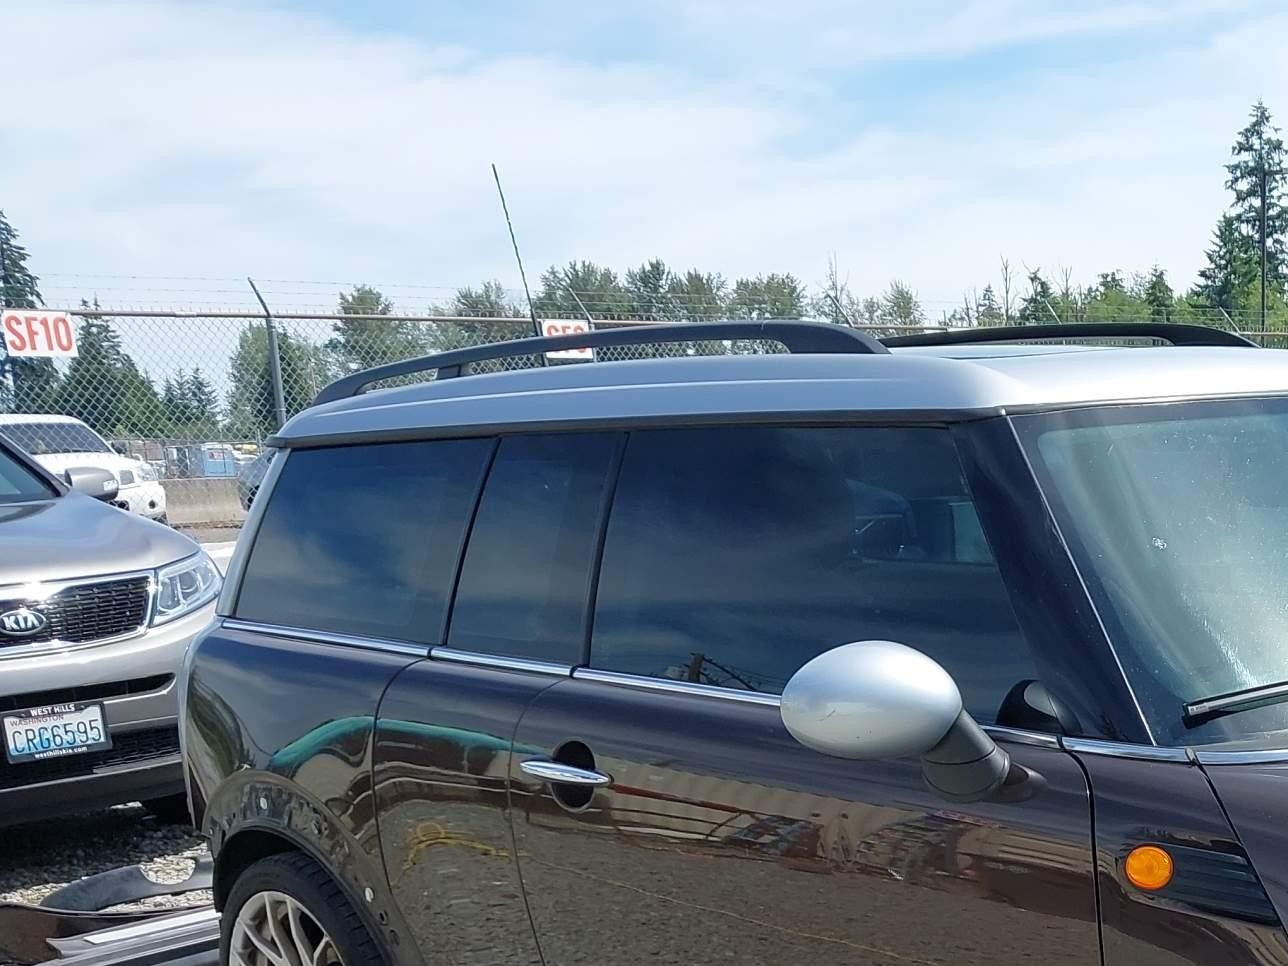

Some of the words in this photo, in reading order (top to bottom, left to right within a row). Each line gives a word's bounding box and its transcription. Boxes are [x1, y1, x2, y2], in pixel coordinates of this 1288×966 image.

[5, 315, 73, 352] SF10
[2, 615, 40, 630] KIA
[30, 706, 53, 717] WEST
[54, 703, 76, 713] HILLS
[9, 714, 64, 727] WASHINGTON
[12, 719, 102, 753] CRG6595
